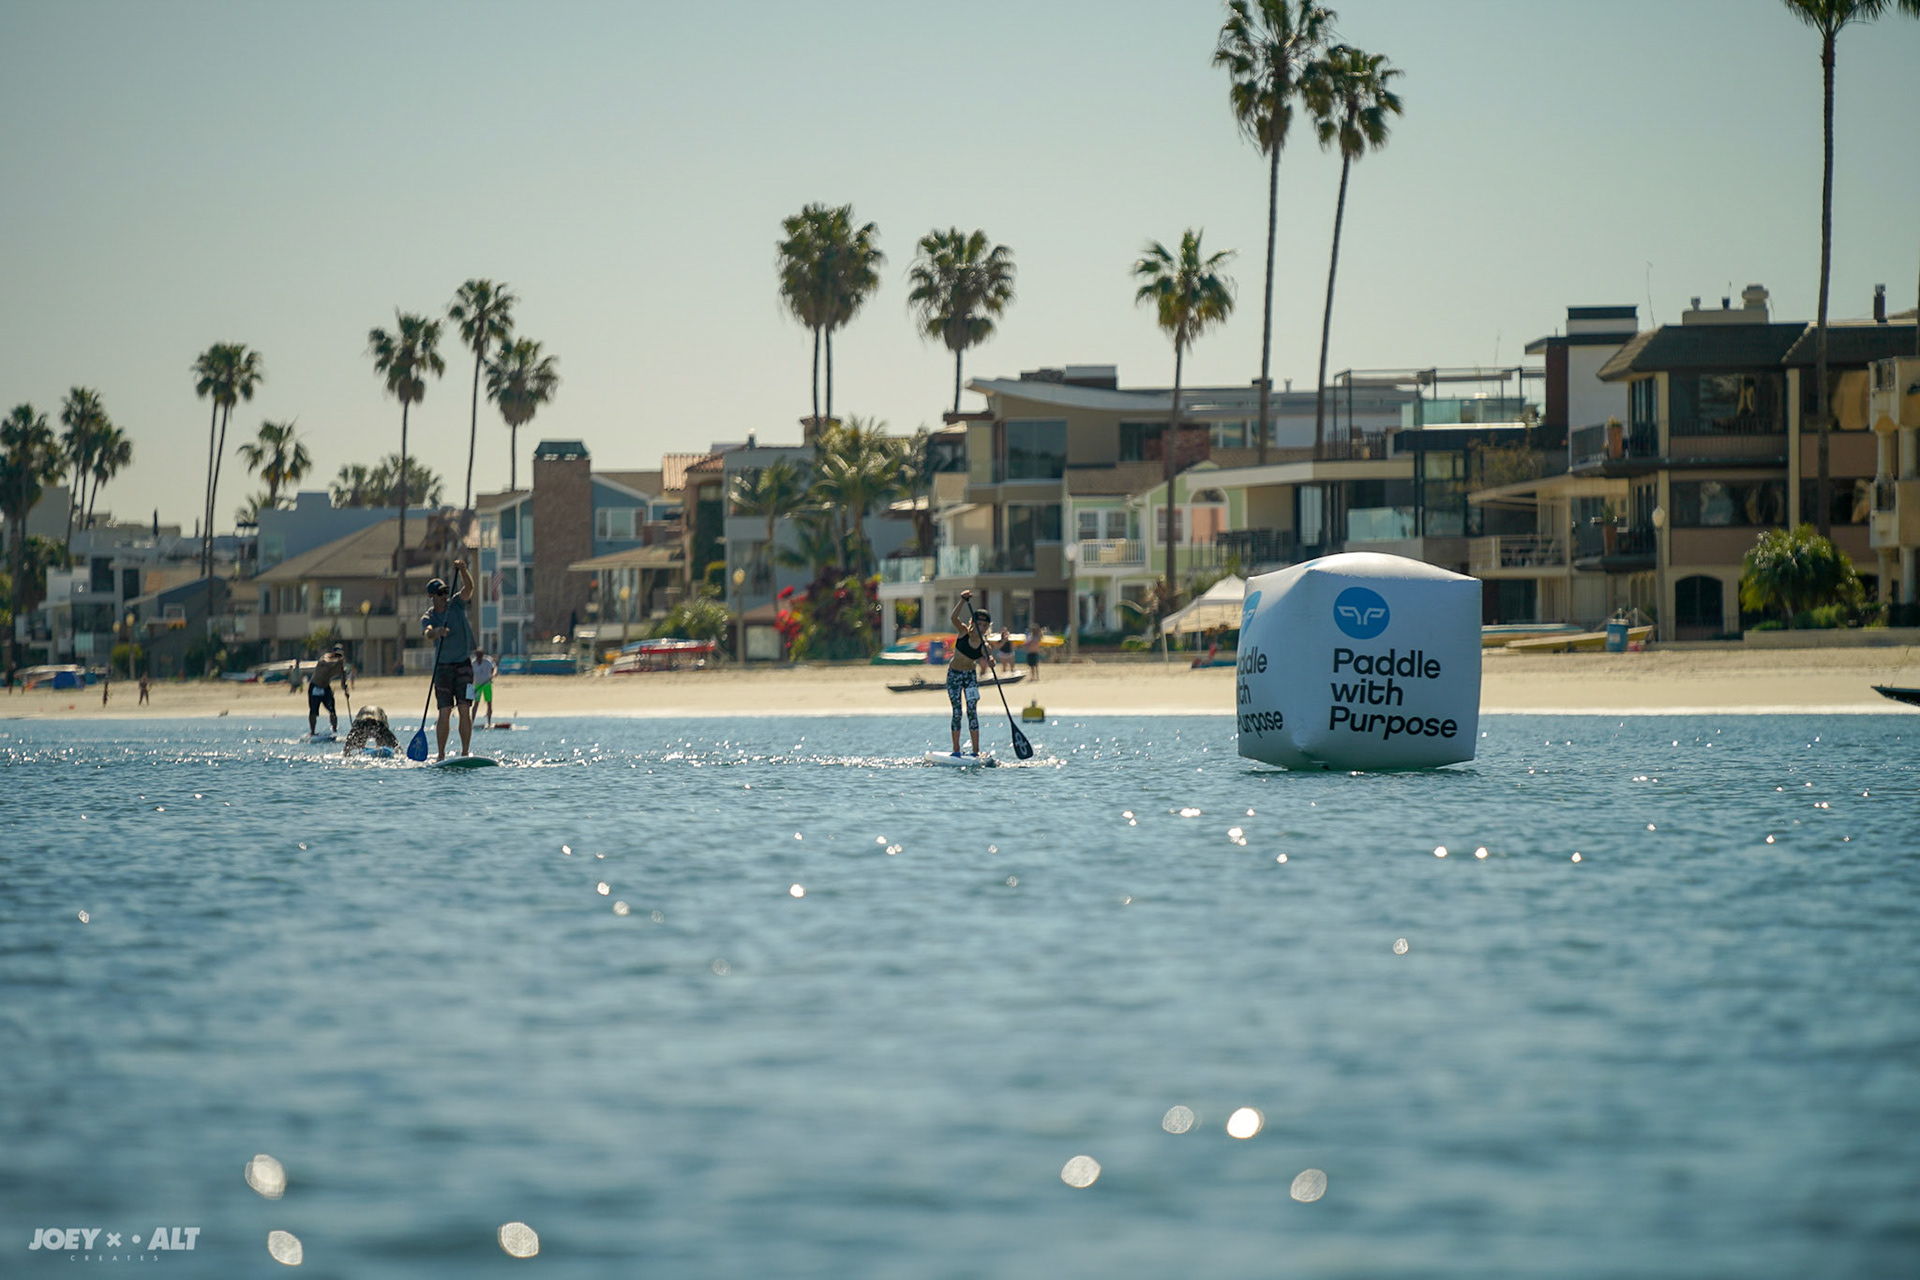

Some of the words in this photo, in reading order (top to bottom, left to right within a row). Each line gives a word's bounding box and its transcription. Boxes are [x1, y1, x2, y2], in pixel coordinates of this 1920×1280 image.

[1237, 646, 1268, 675] ddle
[1333, 648, 1441, 679] Paddle
[1330, 678, 1404, 706] with
[1329, 705, 1458, 740] Purpose
